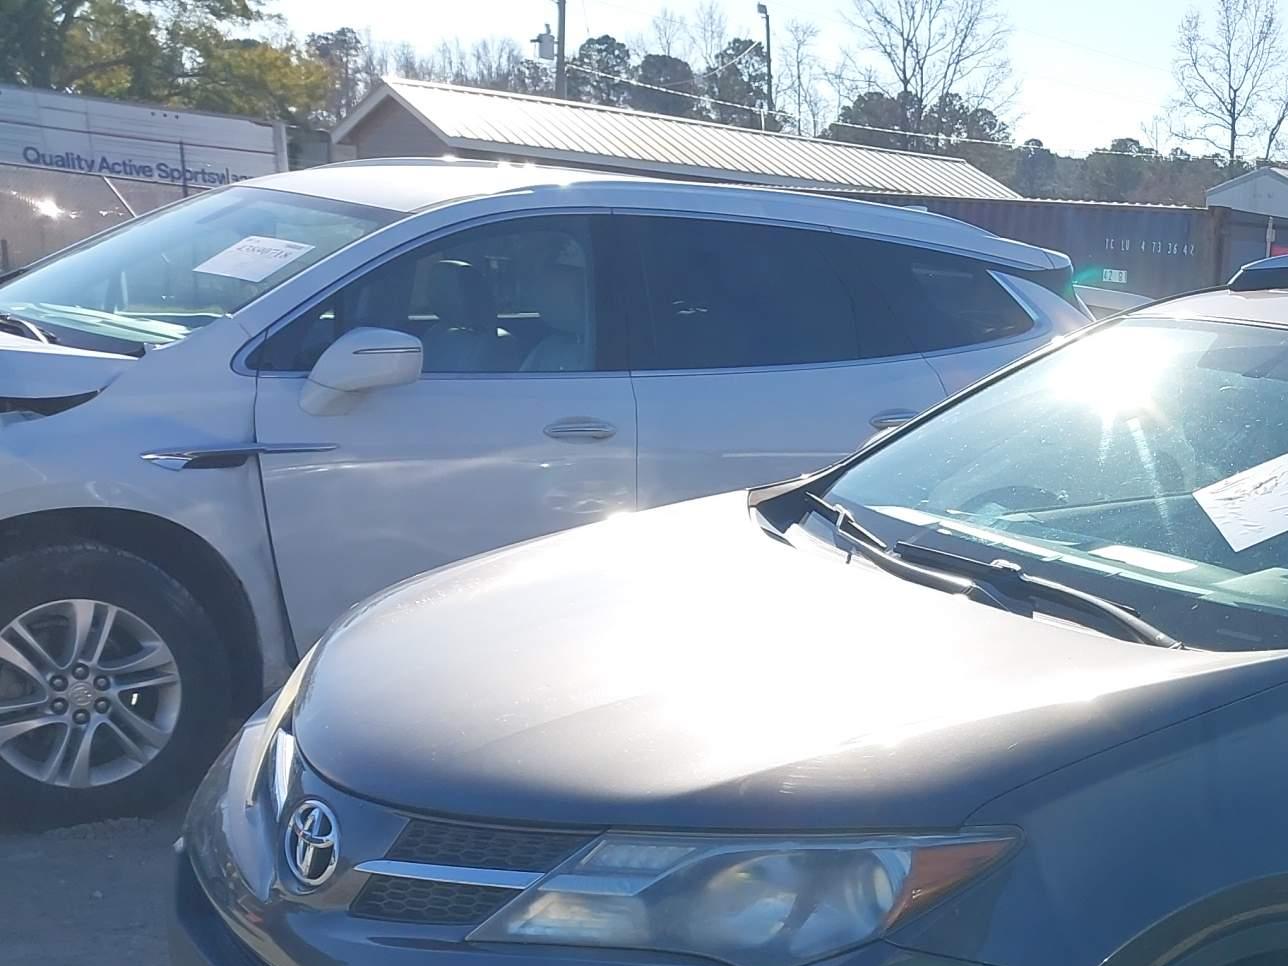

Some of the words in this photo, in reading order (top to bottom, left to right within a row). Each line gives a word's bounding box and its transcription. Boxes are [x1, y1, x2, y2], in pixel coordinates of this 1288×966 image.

[22, 146, 95, 172] Quality
[98, 156, 153, 177] Active
[155, 162, 254, 184] Sportswe
